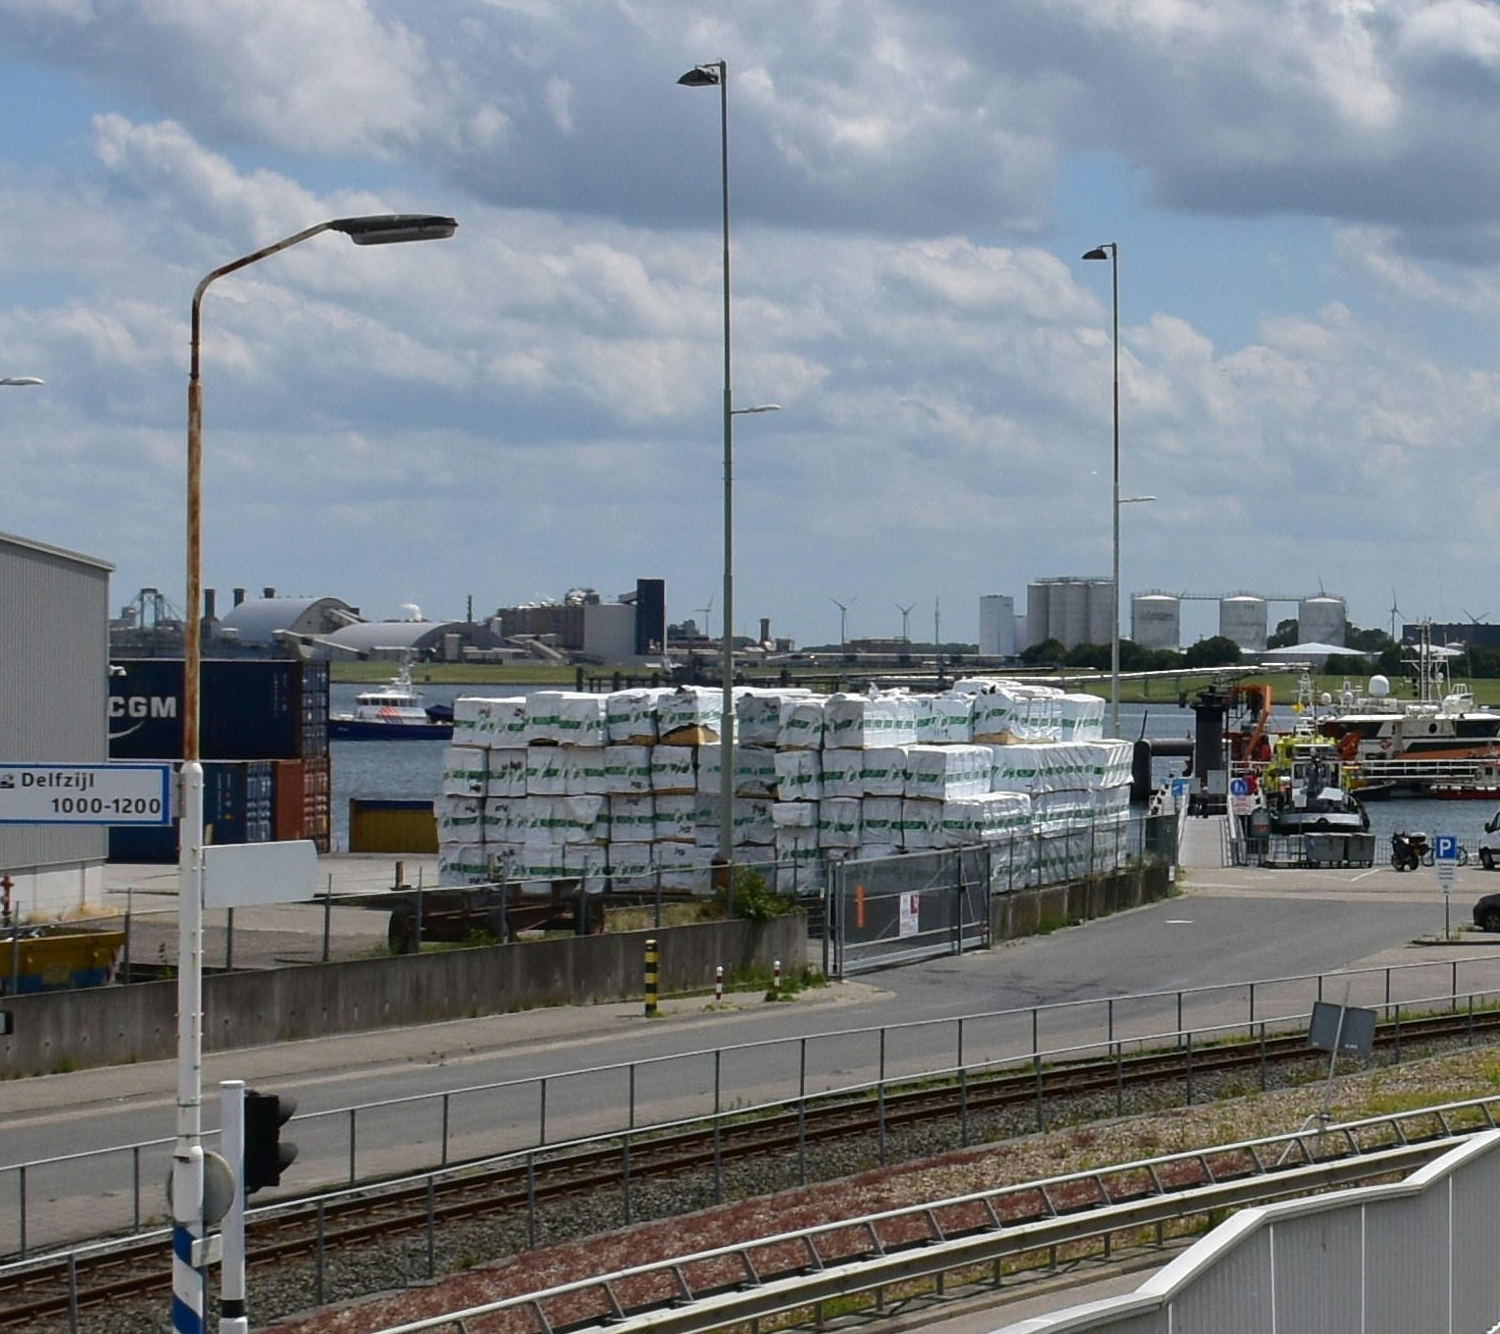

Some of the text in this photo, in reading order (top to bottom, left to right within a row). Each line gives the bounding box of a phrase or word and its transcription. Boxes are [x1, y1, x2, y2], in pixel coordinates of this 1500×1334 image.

[108, 696, 177, 718] CGM
[21, 772, 95, 791] Delfzijl
[51, 797, 161, 814] 1000-1200
